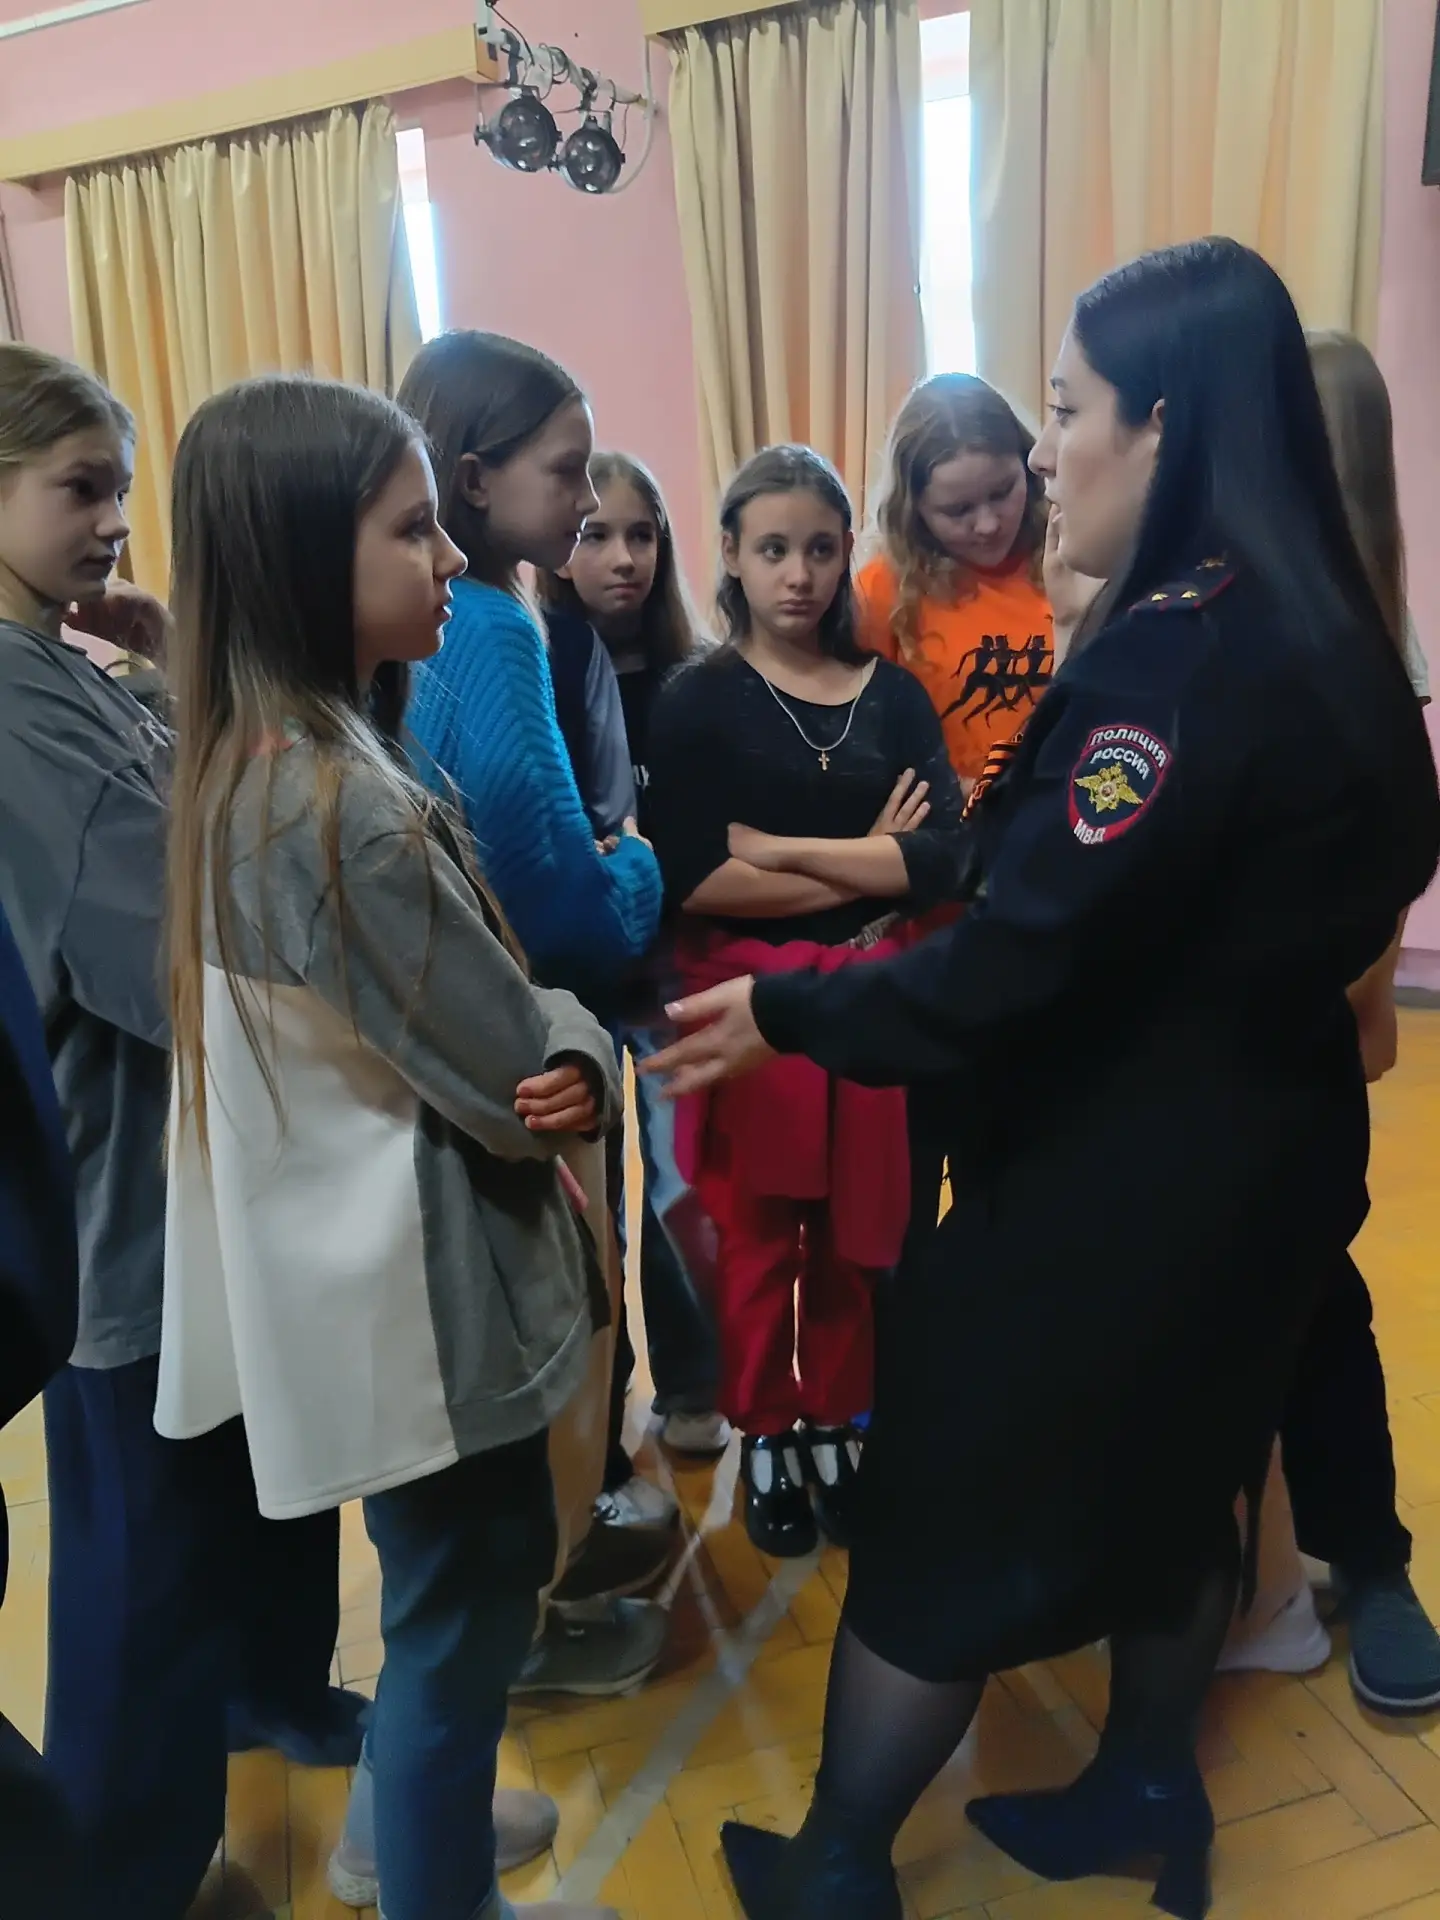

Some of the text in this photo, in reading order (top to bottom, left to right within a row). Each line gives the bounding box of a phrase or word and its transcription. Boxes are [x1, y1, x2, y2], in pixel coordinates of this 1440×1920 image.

[1089, 747, 1150, 780] РОССИЯ
[1091, 728, 1166, 767] ПОЛИЦИЯ
[1073, 818, 1106, 844] МВД
